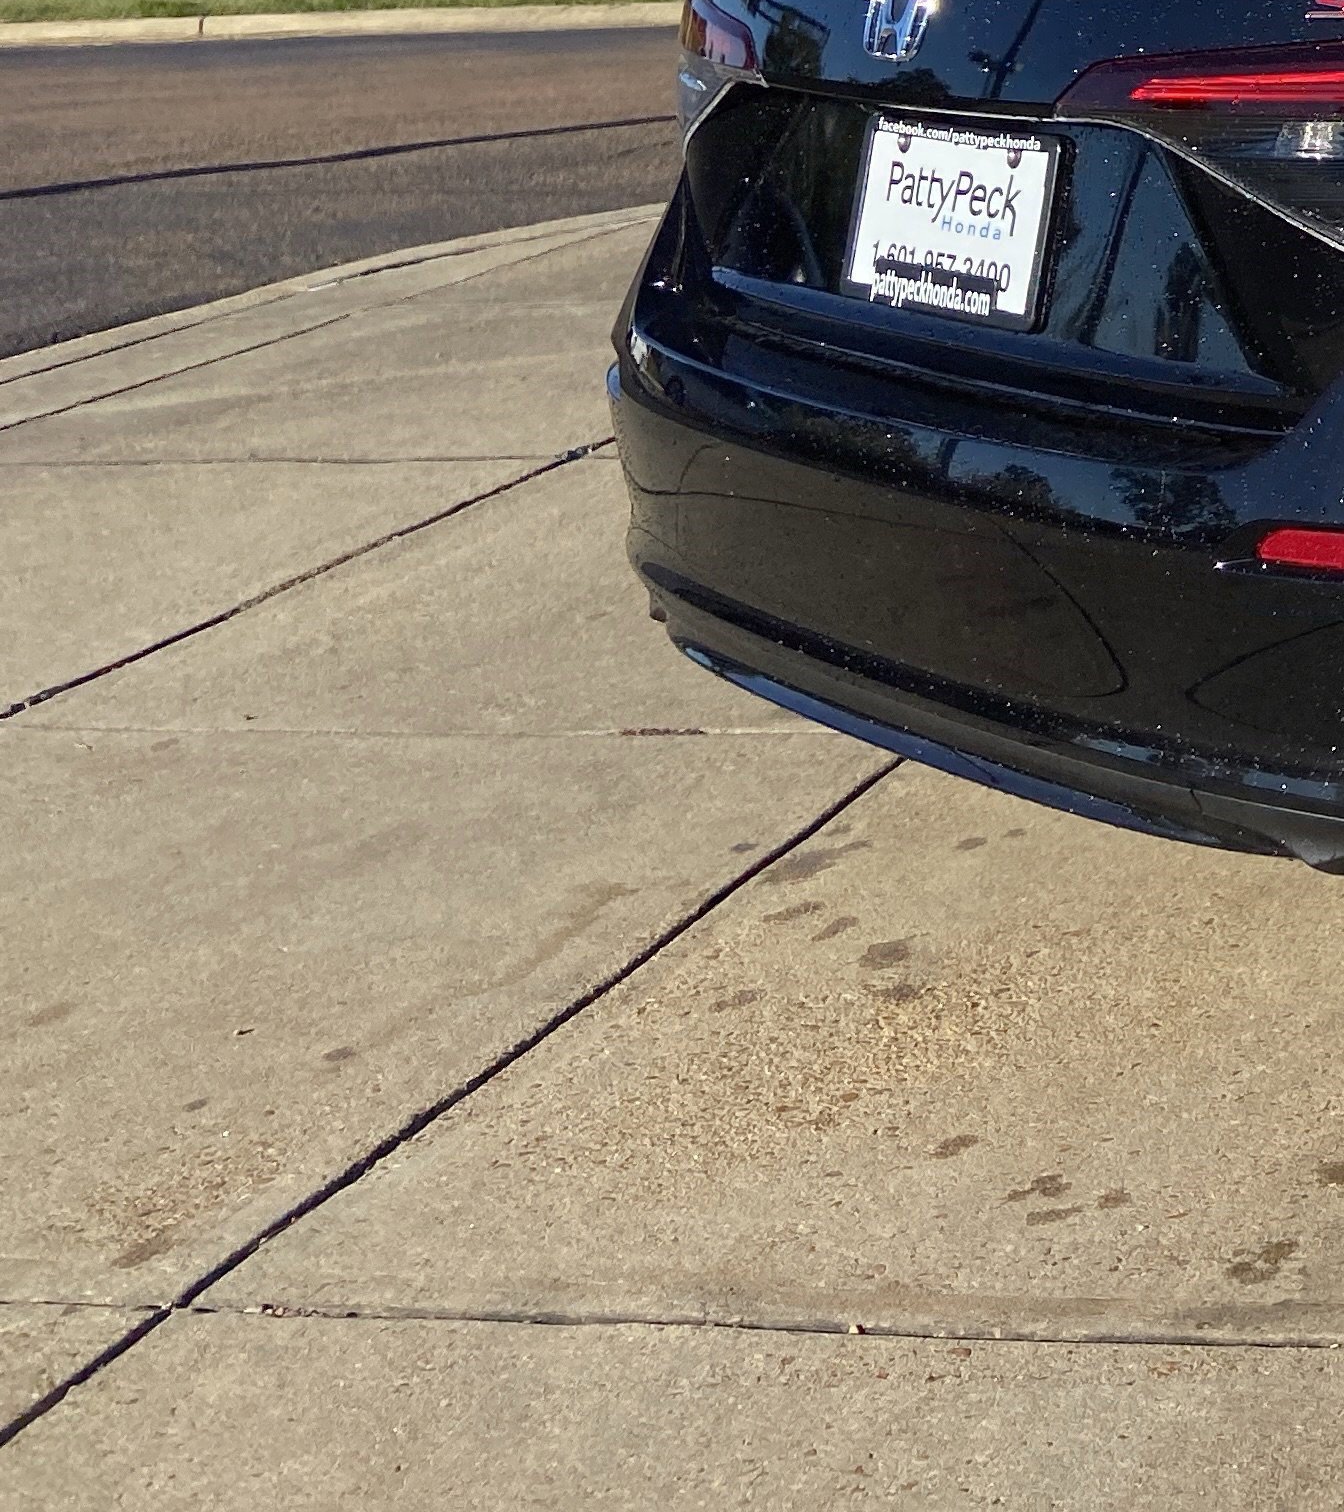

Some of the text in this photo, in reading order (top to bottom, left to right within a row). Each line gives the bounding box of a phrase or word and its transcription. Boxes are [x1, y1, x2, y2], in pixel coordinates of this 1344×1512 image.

[878, 116, 1041, 152] facebook.com/pattypeckhonda
[886, 160, 1022, 238] PattyPeck
[941, 215, 1002, 240] Honda
[869, 269, 991, 316] pattypeckhonda.com
